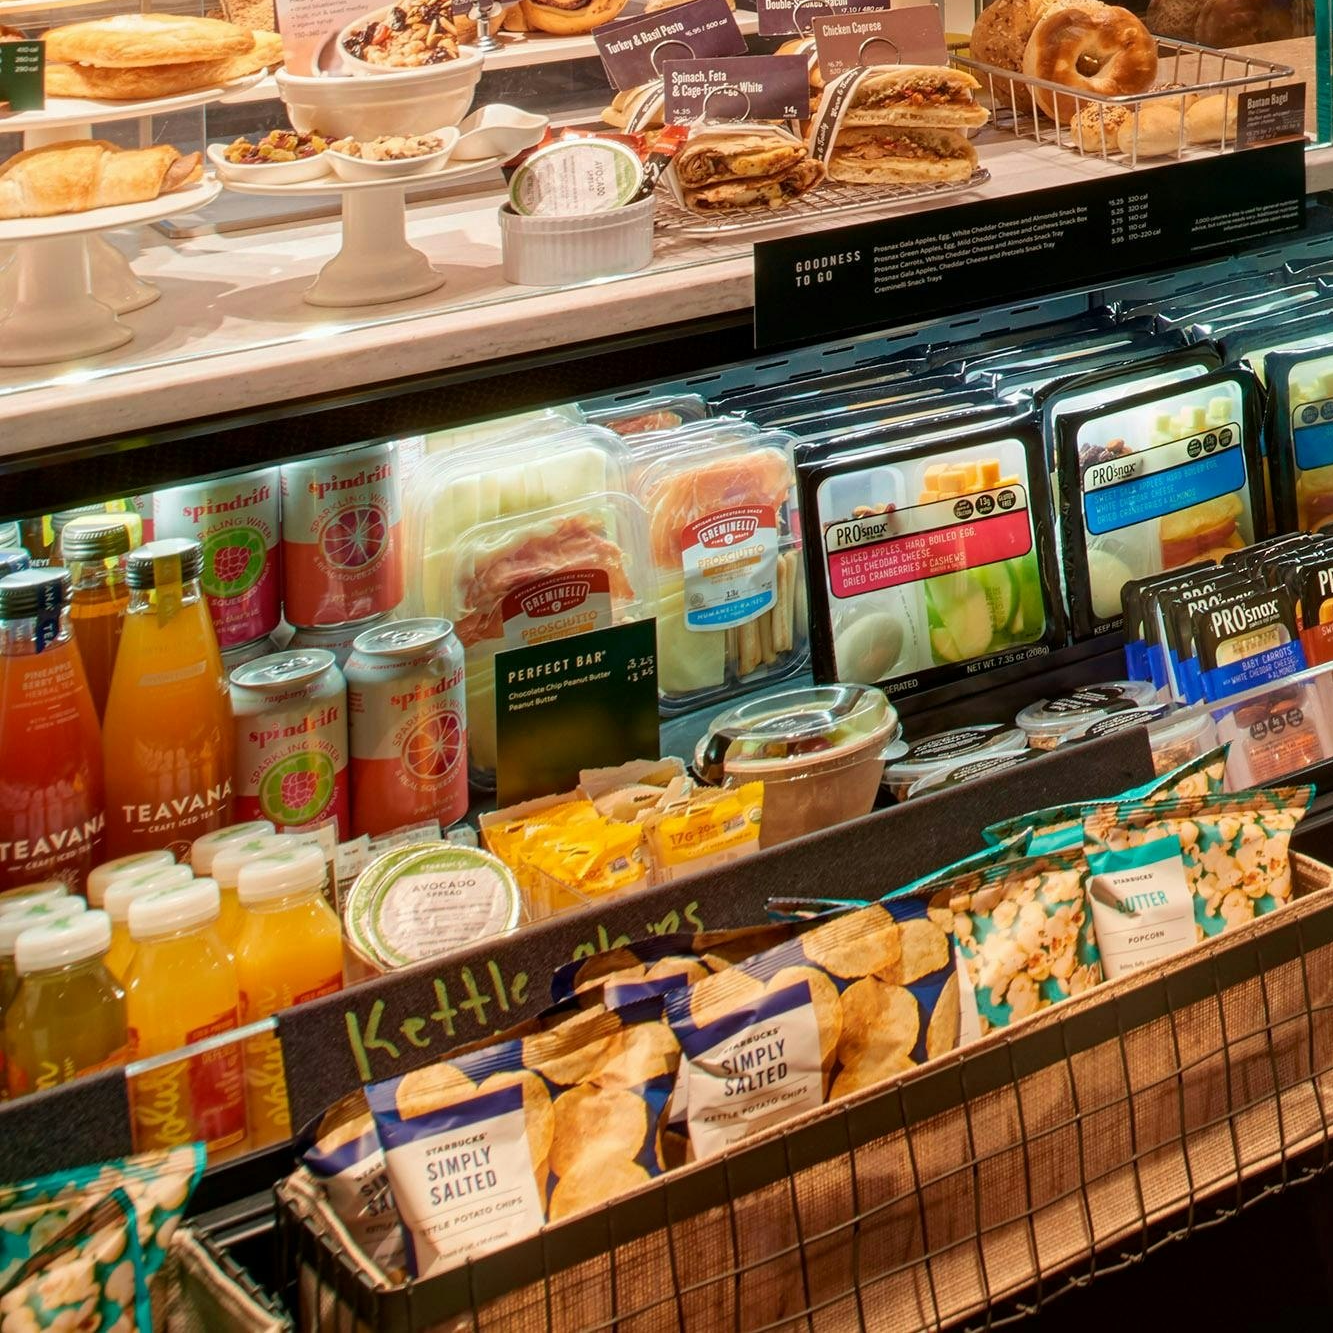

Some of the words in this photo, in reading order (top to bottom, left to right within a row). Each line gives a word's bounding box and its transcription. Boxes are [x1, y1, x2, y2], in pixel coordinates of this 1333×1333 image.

[605, 33, 634, 55] Turkey
[633, 33, 643, 47] &
[641, 27, 661, 44] Basil
[661, 21, 685, 39] Pesto
[822, 24, 852, 37] Chicken
[851, 21, 882, 35] Caprese
[1247, 94, 1271, 110] Bantam
[1271, 90, 1289, 108] Bagel
[794, 249, 862, 274] GOODNESS
[795, 274, 813, 287] TO
[816, 270, 834, 284] GO
[181, 484, 271, 523] spindrift
[701, 520, 755, 543] CREMINELLI
[840, 551, 868, 566] SLICED
[870, 543, 902, 558] APPLES,
[904, 537, 925, 550] HARD
[928, 530, 957, 545] BOILED
[958, 526, 976, 539] EGG,
[524, 584, 588, 612] CREMINELLI
[507, 659, 570, 684] PERFECT
[576, 651, 603, 668] BAR
[248, 705, 340, 750] spindrift
[122, 779, 233, 823] TEAVANA
[411, 878, 477, 892] AVOCADO
[1113, 873, 1153, 886] STARBUCKS
[1116, 890, 1169, 914] BUTTER
[1128, 930, 1165, 945] POPCORN
[344, 959, 530, 1083] Kettle
[721, 1038, 786, 1076] SIMPLY
[724, 1062, 788, 1098] SALTED
[425, 1133, 486, 1157] STARBUCKS
[426, 1145, 491, 1182] SIMPLY
[430, 1169, 498, 1207] SALTED
